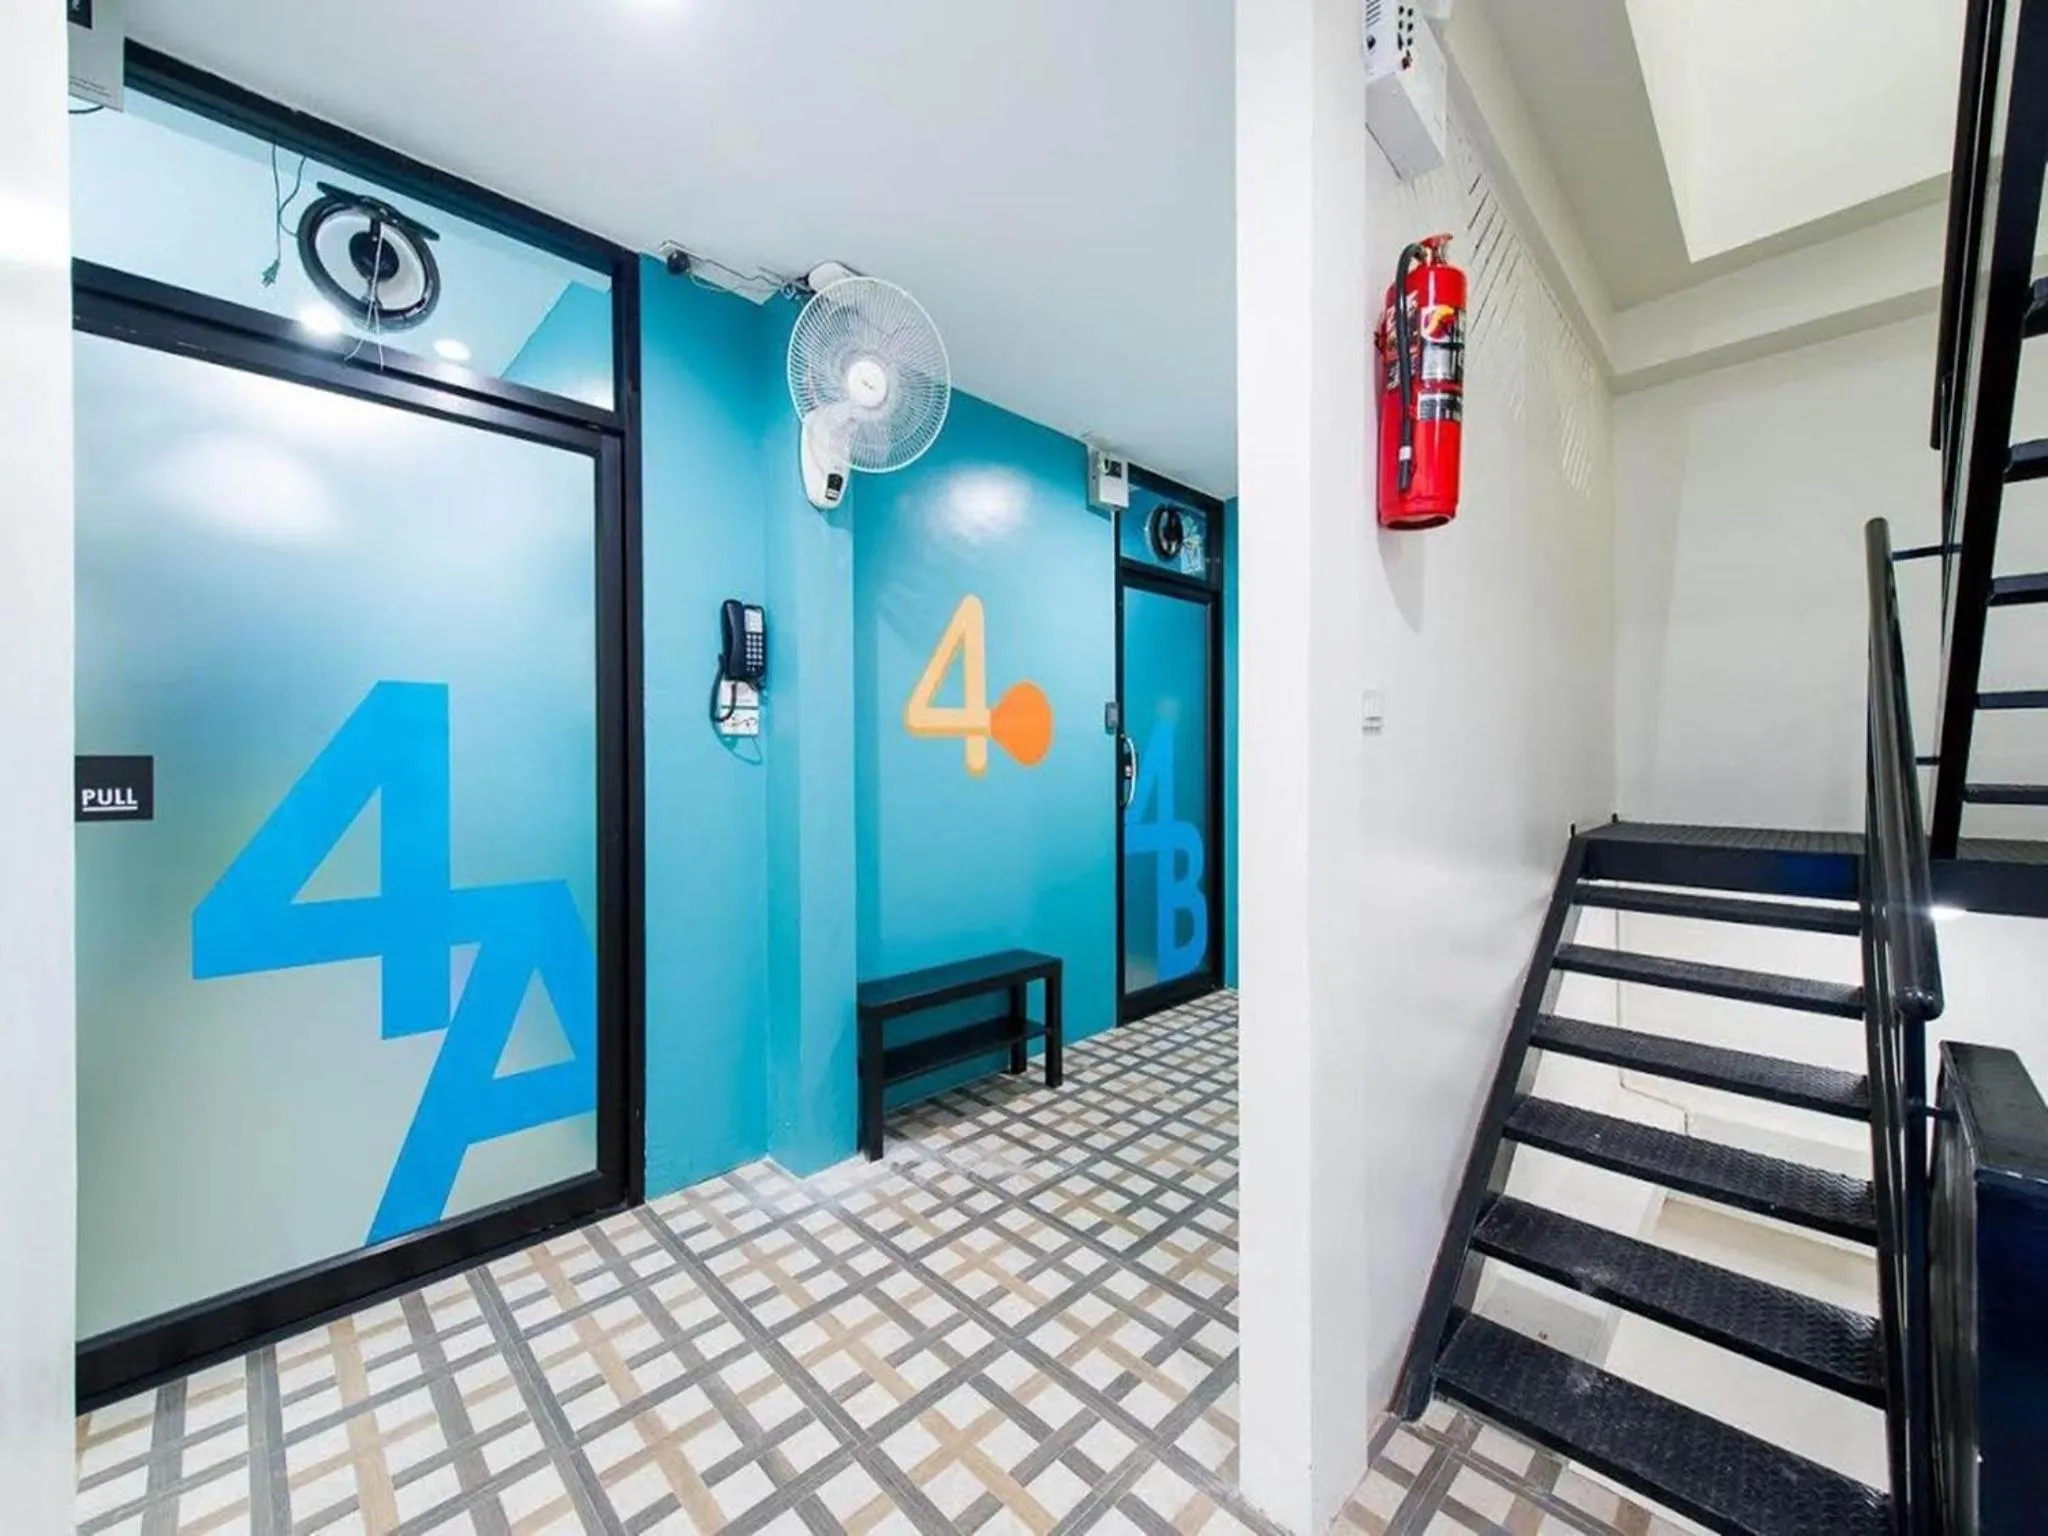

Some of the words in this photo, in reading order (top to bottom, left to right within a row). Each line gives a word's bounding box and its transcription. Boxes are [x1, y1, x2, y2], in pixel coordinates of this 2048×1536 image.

[82, 788, 138, 806] PULL
[1124, 712, 1208, 982] 4B
[191, 680, 597, 1246] 4A
